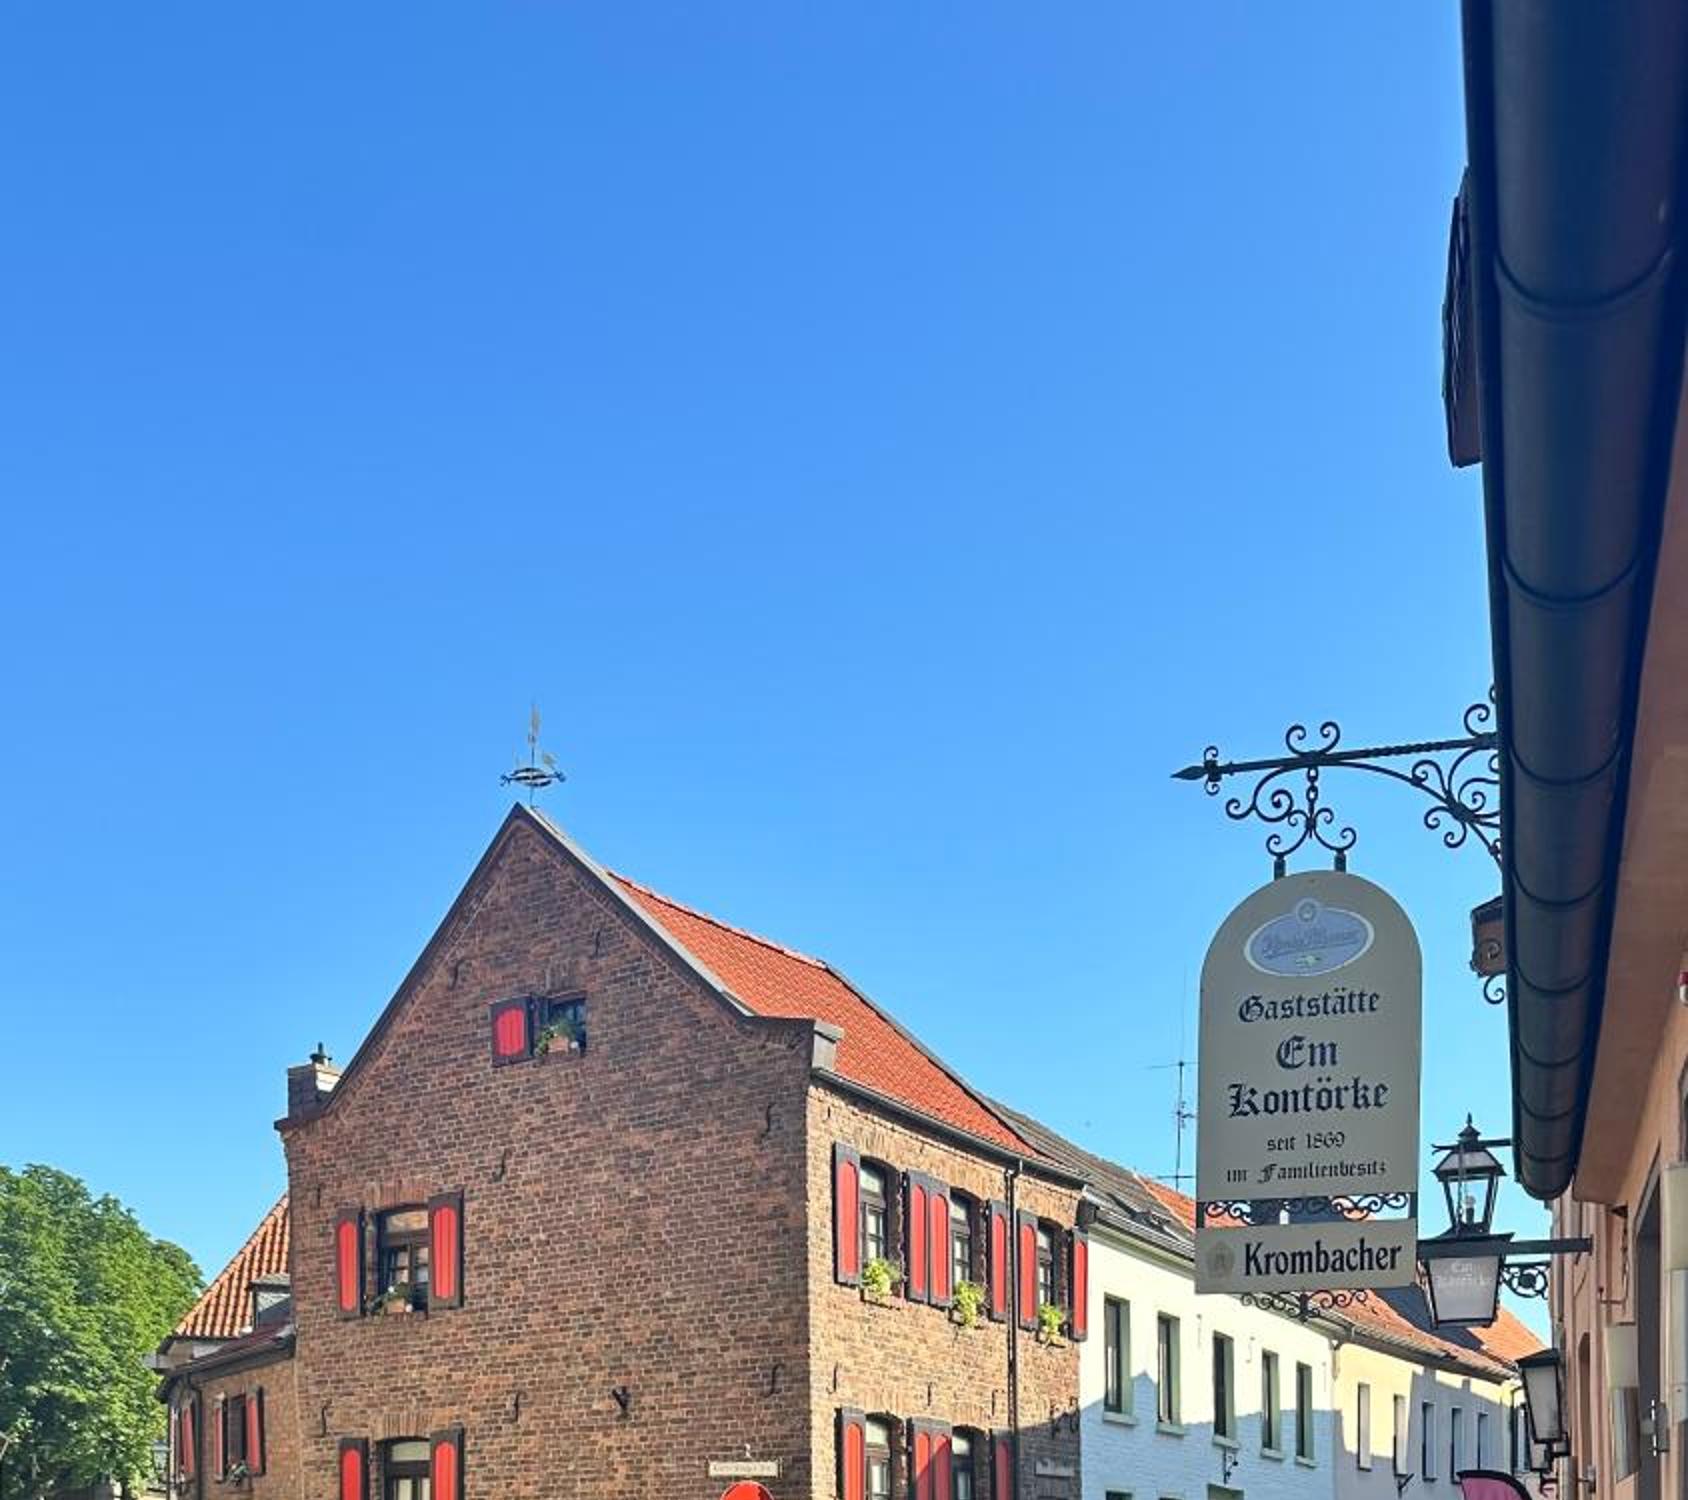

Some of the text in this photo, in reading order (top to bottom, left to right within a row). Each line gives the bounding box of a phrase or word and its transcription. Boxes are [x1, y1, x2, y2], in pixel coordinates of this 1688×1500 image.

[1238, 986, 1380, 1022] Gaststätte
[1275, 1034, 1338, 1069] Em
[1227, 1076, 1389, 1118] Kontörke
[1267, 1131, 1346, 1151] seit 1869
[1226, 1160, 1387, 1184] im Familienbesitz
[1244, 1237, 1403, 1277] Krombacher
